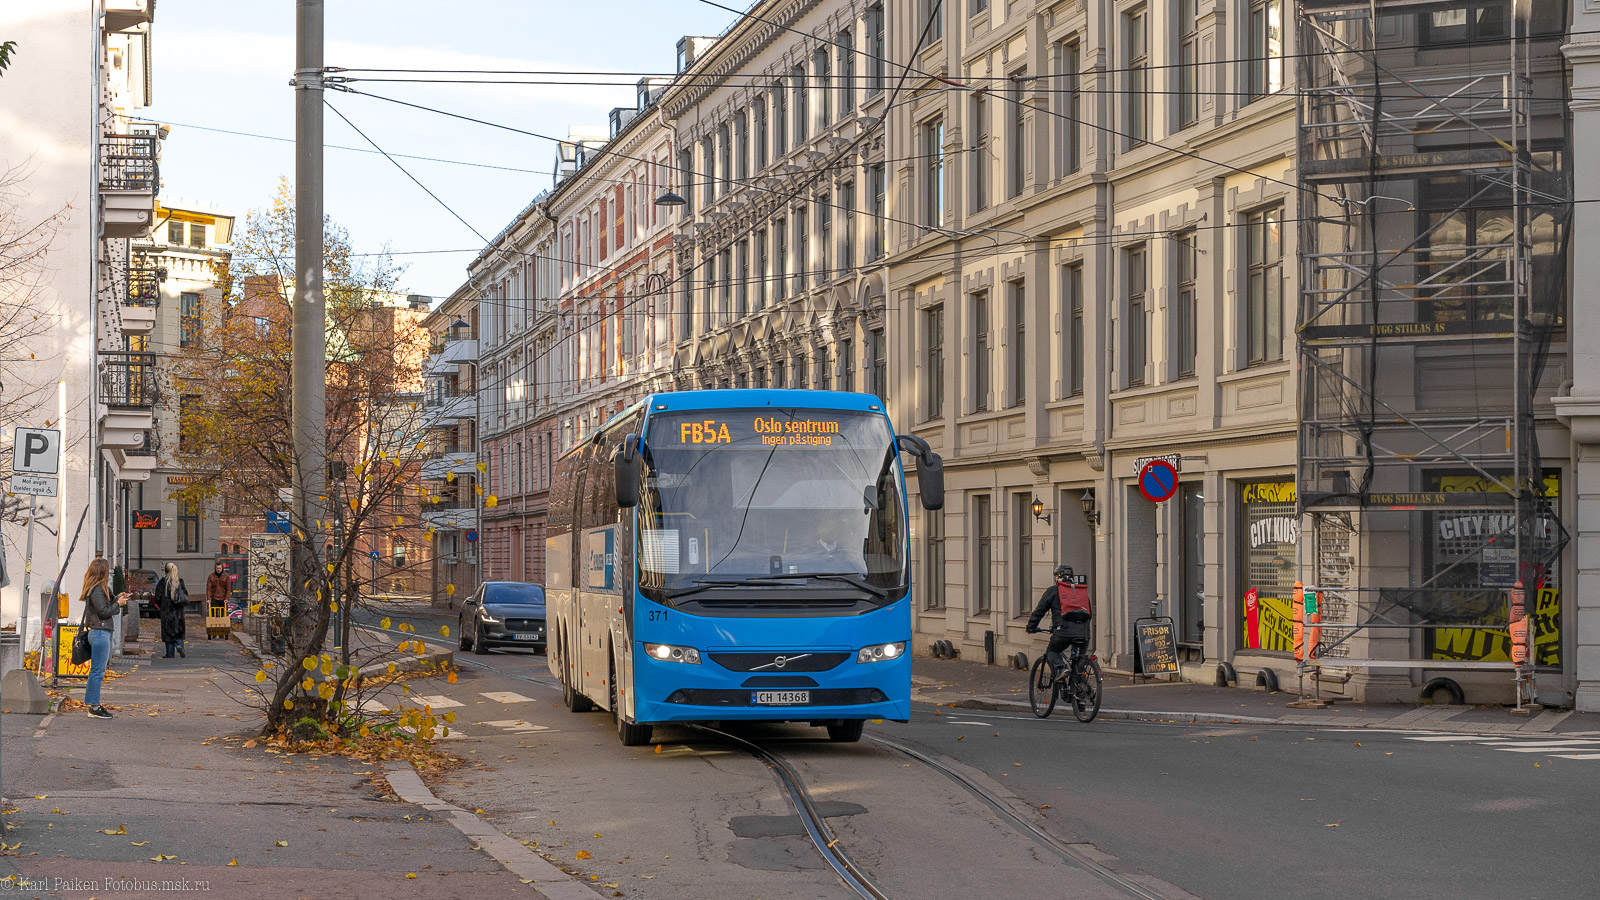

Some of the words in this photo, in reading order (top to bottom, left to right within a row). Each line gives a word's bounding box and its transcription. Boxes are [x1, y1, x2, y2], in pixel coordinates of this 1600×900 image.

[1395, 323, 1431, 334] STILLAS
[1433, 322, 1446, 333] AS
[754, 417, 782, 433] Oslo
[785, 419, 839, 433] sentrum
[680, 420, 731, 443] FB5A
[762, 434, 787, 446] Ingen
[789, 434, 832, 446] påstiging
[24, 433, 49, 467] P
[1370, 494, 1393, 503] BYGG
[1395, 493, 1431, 504] STILLAS
[1433, 493, 1446, 503] AS
[1250, 517, 1272, 548] CITY
[1273, 517, 1297, 545] KIOS
[1440, 515, 1484, 540] CITY
[648, 610, 668, 621] 371
[1264, 606, 1277, 630] City
[1142, 626, 1170, 636] FRISØR
[1145, 663, 1166, 672] DROP
[1167, 662, 1177, 671] IN
[760, 693, 773, 702] CH
[776, 692, 807, 702] 14368
